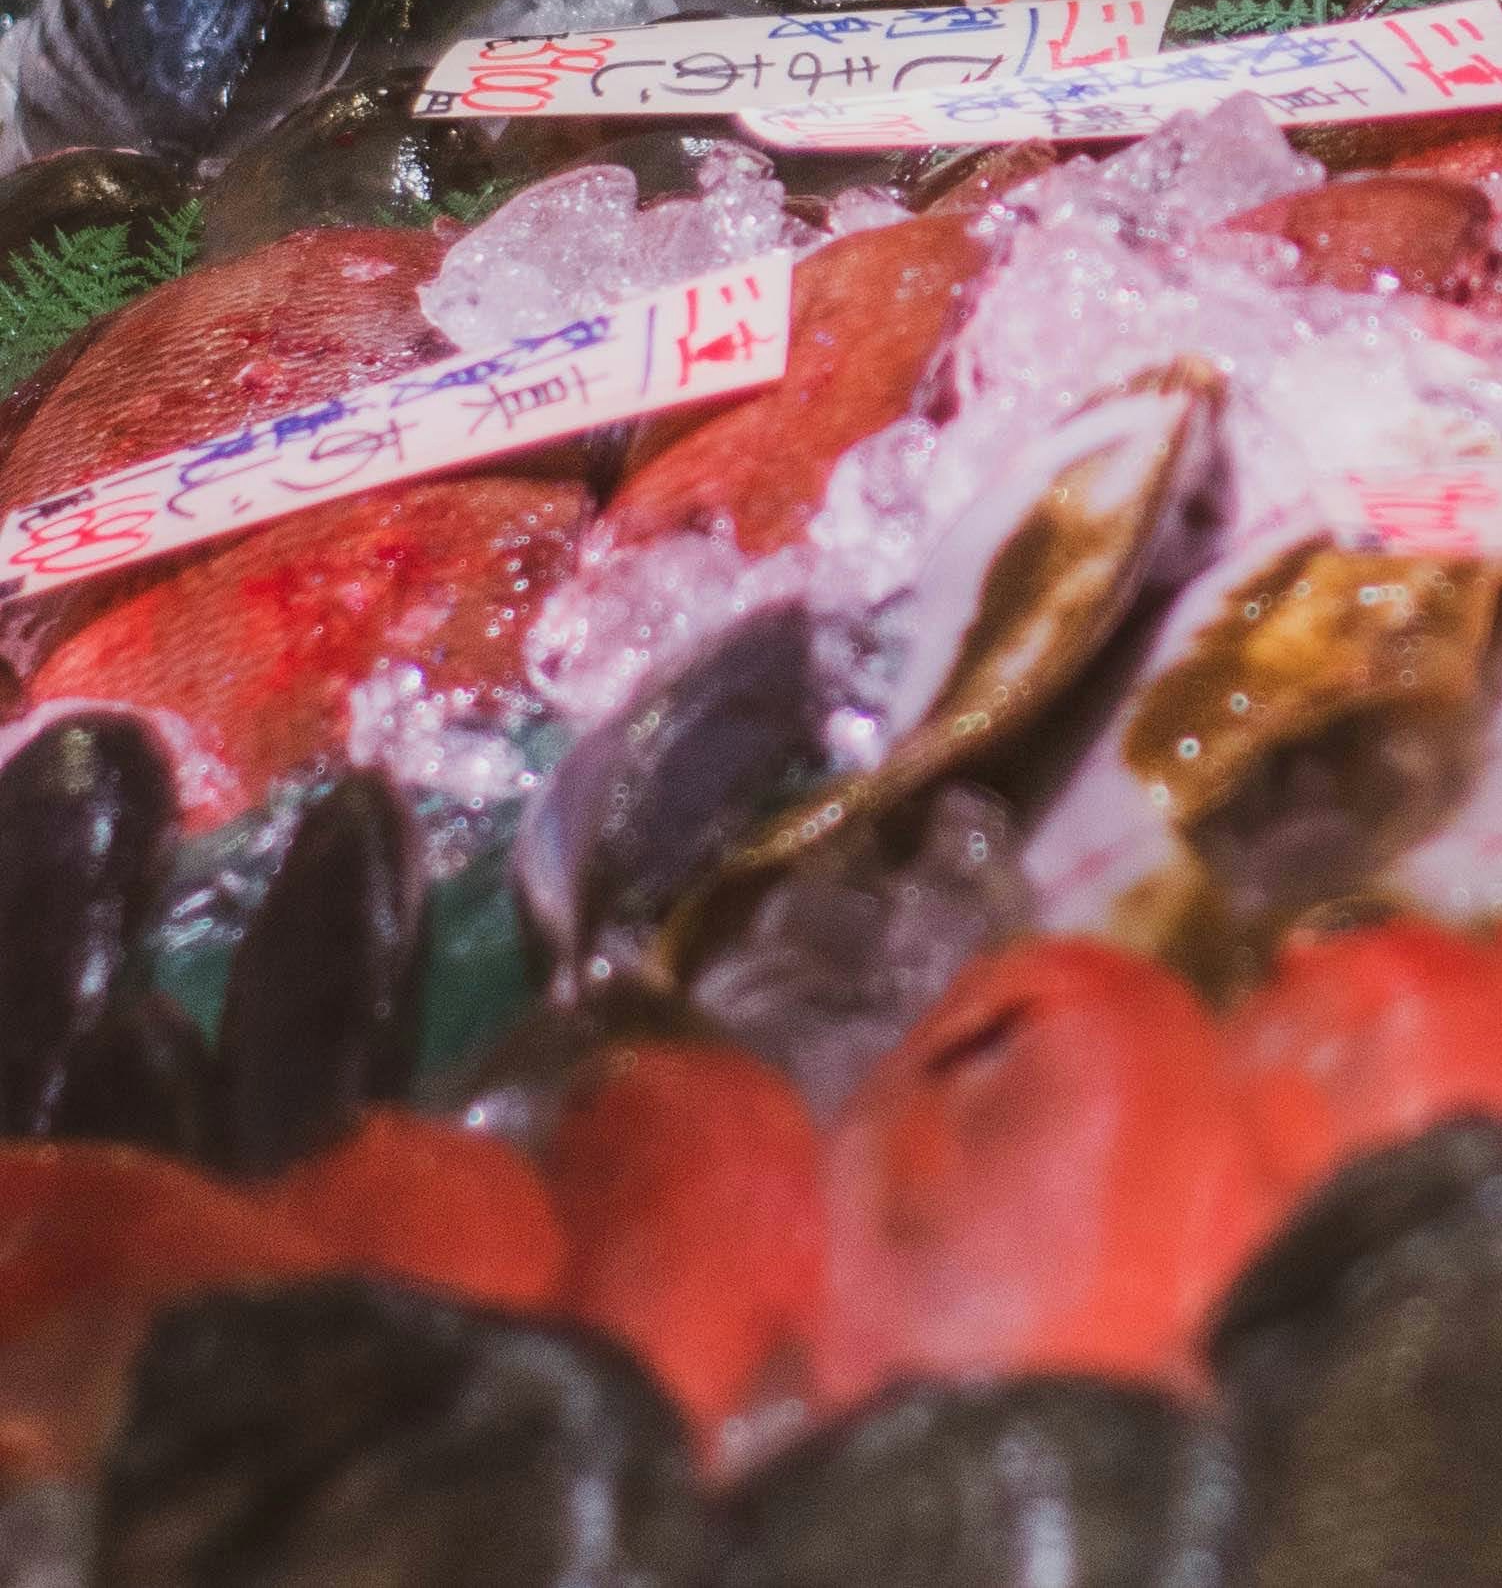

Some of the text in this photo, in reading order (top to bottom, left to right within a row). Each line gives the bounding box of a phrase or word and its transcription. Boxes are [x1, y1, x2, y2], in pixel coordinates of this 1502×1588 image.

[461, 36, 617, 112] 3900
[676, 276, 776, 388] 三重
[166, 363, 609, 520] 真あじ
[8, 490, 159, 575] 680
